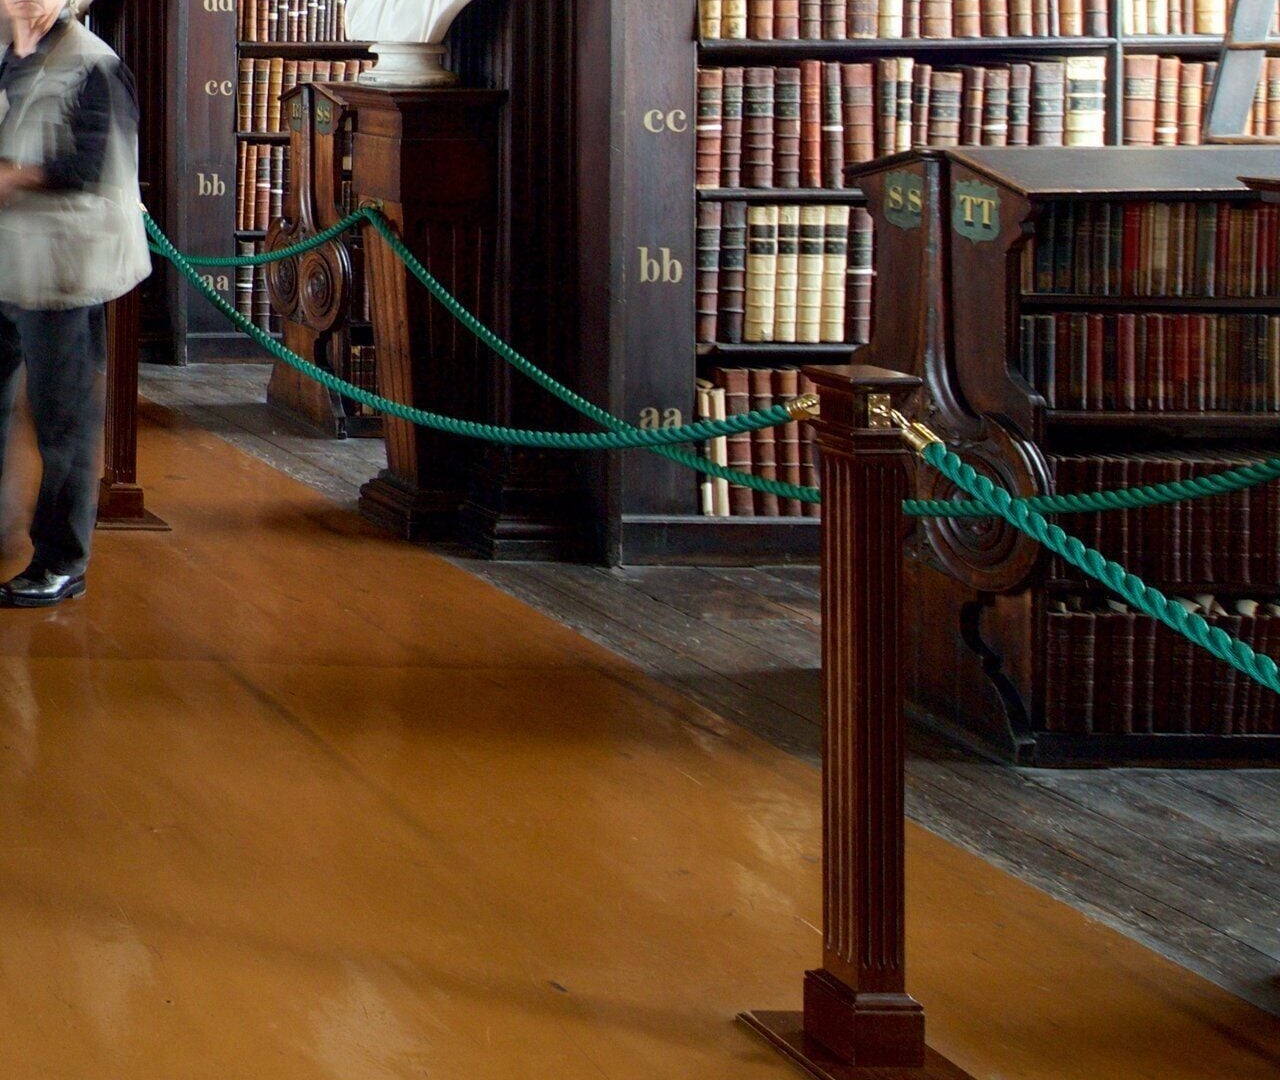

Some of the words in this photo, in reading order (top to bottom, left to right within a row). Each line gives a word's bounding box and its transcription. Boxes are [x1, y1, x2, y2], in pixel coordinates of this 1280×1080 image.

[205, 80, 232, 96] cc
[317, 107, 330, 121] SS
[644, 108, 687, 133] cc
[197, 174, 225, 196] bb
[889, 186, 921, 213] SS
[959, 195, 996, 224] TT
[638, 248, 682, 284] bb
